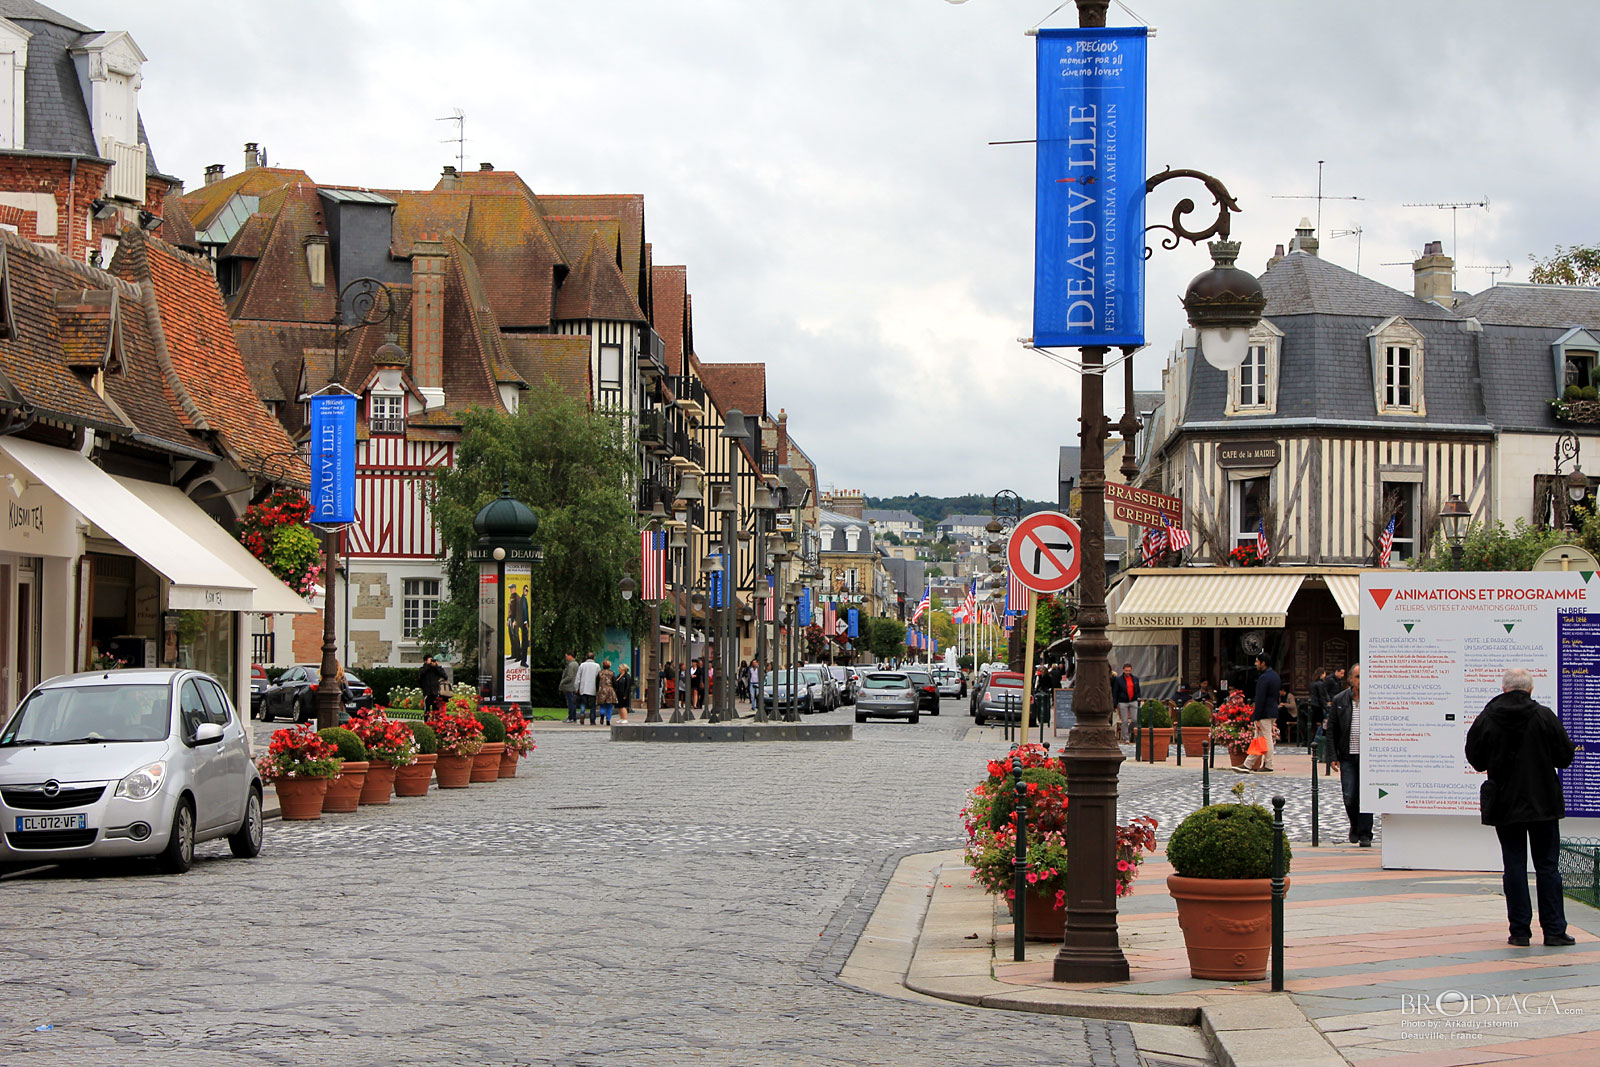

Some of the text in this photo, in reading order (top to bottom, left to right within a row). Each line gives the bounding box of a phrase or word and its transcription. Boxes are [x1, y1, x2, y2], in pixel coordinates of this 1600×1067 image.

[1112, 54, 1123, 65] all
[1104, 103, 1117, 332] FESTIVAL DU CINÉMA AMÉRICAIN
[1238, 451, 1246, 459] de
[1246, 450, 1252, 458] la
[1254, 449, 1276, 458] MAIRIE
[1107, 484, 1180, 513] BRASSERIE
[8, 499, 44, 534] KUSMI TEA
[1394, 588, 1587, 601] ANIMATIONS ET PROGRAMME
[1427, 604, 1451, 612] VISITES
[1451, 604, 1459, 612] ET
[1461, 604, 1504, 612] ANIMATIONS
[1505, 604, 1538, 612] GRATUITS
[1121, 616, 1282, 626] BRASSERIE DE LA MAIRIE
[24, 816, 77, 830] CL-072-VF
